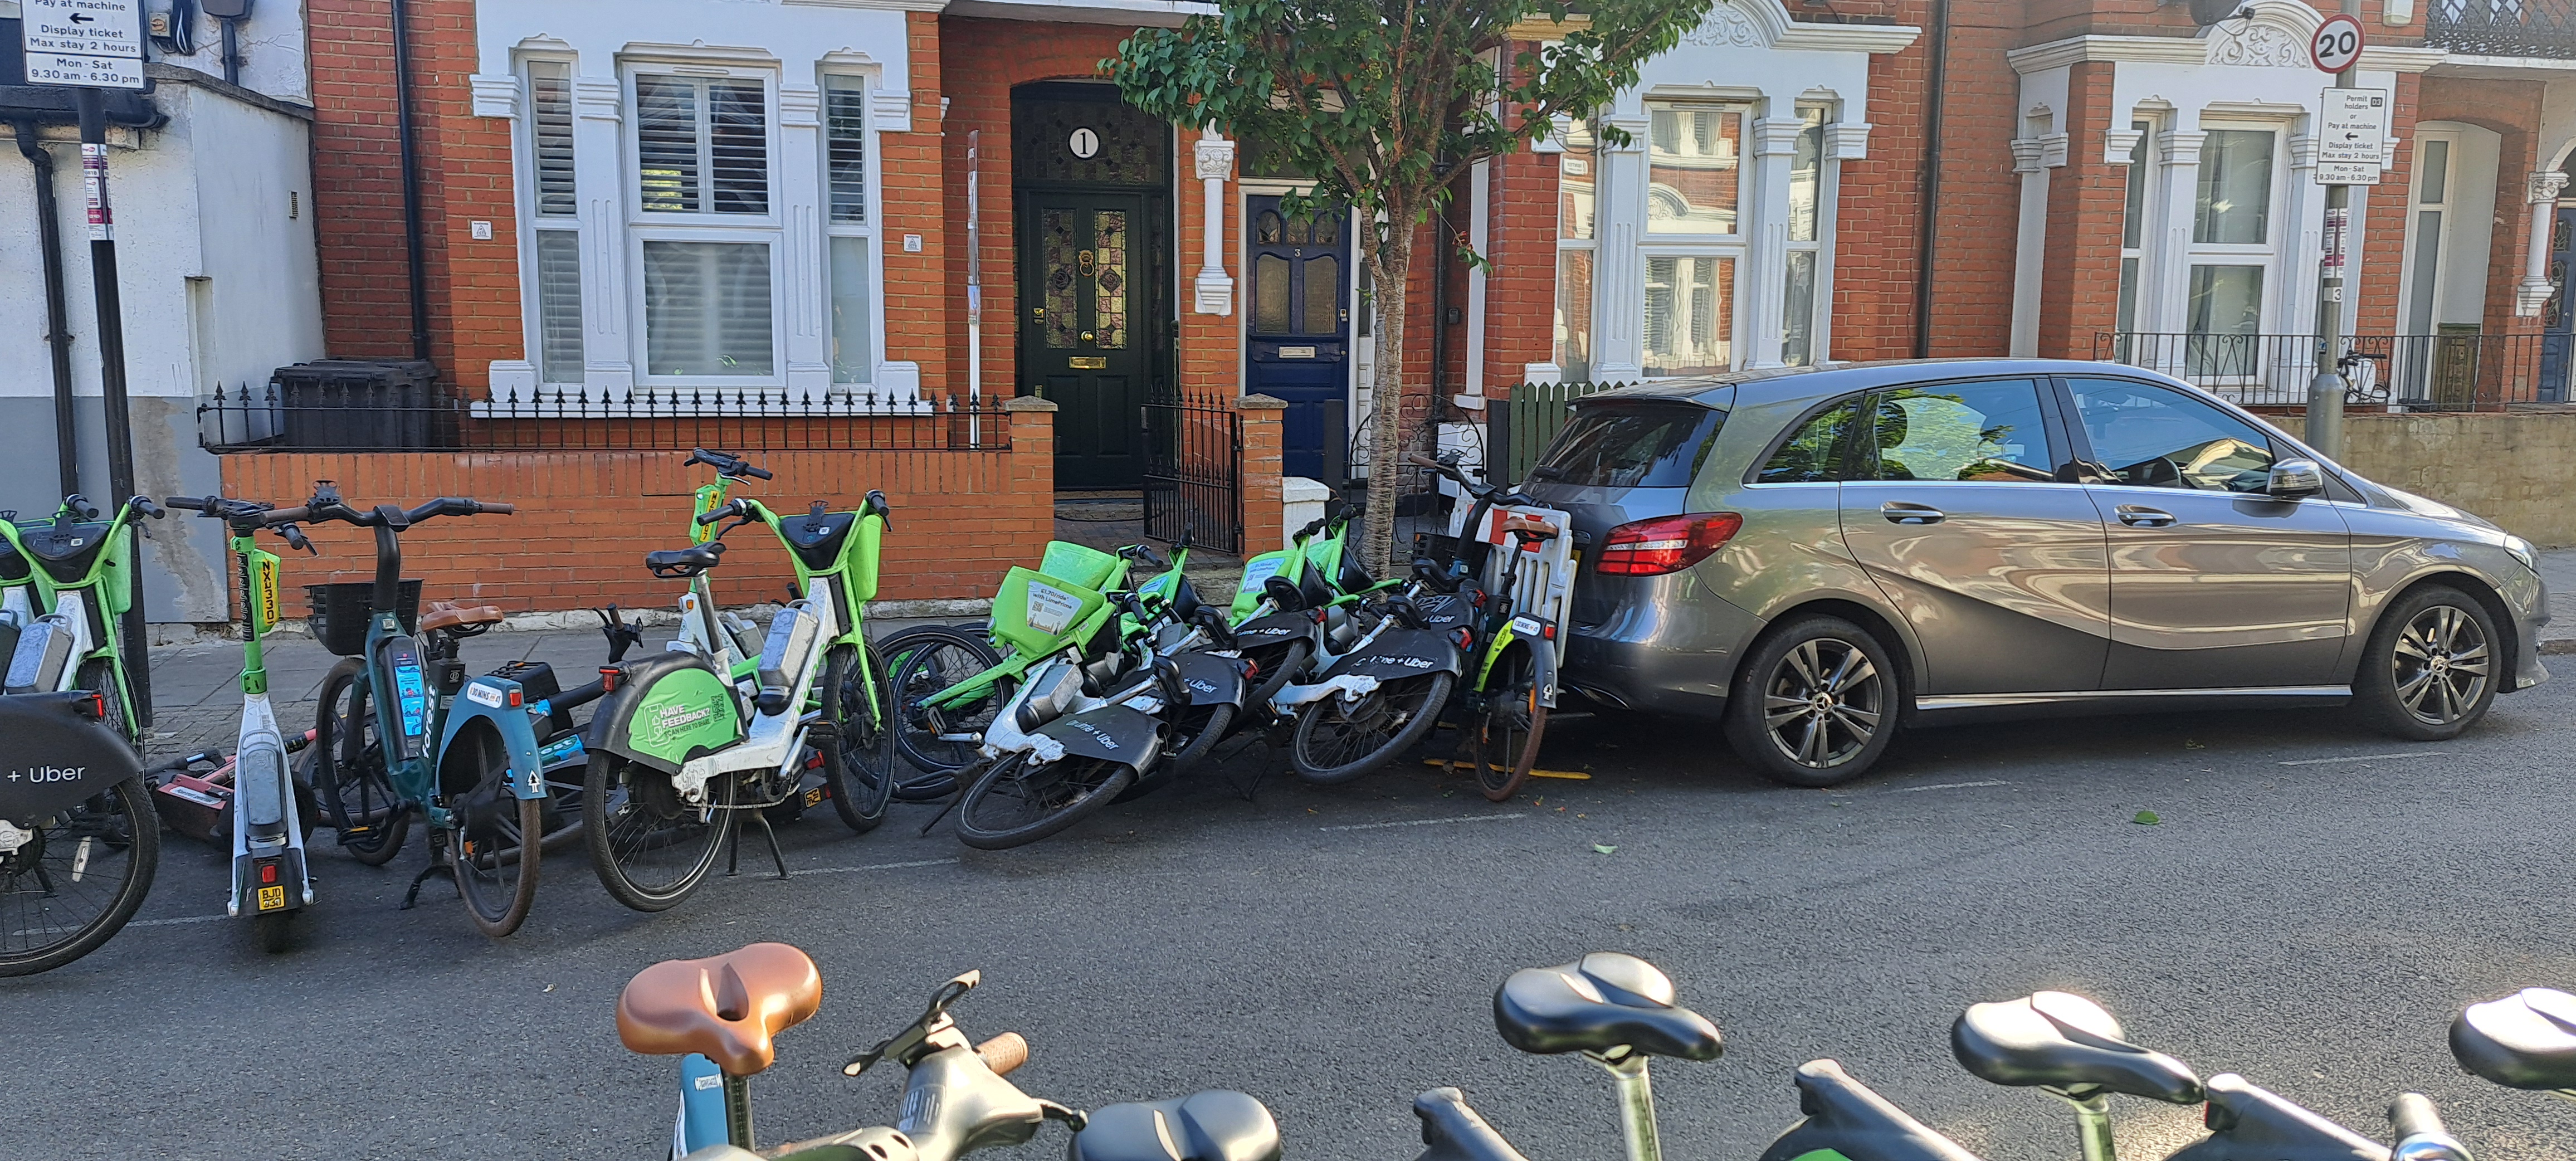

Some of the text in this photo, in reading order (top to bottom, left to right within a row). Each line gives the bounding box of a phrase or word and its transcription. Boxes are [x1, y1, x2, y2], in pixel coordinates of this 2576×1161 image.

[77, 1, 125, 11] machine
[41, 25, 123, 38] Display ticket
[30, 37, 54, 47] Max
[60, 40, 85, 50] stay
[104, 42, 136, 52] hours
[2319, 31, 2355, 58] 20
[57, 58, 82, 67] Mon
[92, 60, 113, 70] Sat
[31, 69, 60, 79] 9.30
[90, 72, 118, 82] 6.30
[122, 75, 139, 84] pm
[1079, 131, 1089, 155] 1
[1294, 248, 1301, 257] 3
[2334, 289, 2341, 300] 3
[1046, 596, 1072, 609] LimePrime
[1404, 657, 1434, 669] Uber
[1189, 679, 1218, 694] Uber
[660, 704, 685, 719] HAVE
[662, 708, 710, 729] FEEDBACK?
[422, 684, 436, 759] forest
[664, 728, 679, 737] SCAN
[698, 718, 711, 728] SHARE
[1096, 733, 1119, 750] Uber
[30, 765, 85, 783] Uber
[262, 888, 281, 899] BJD
